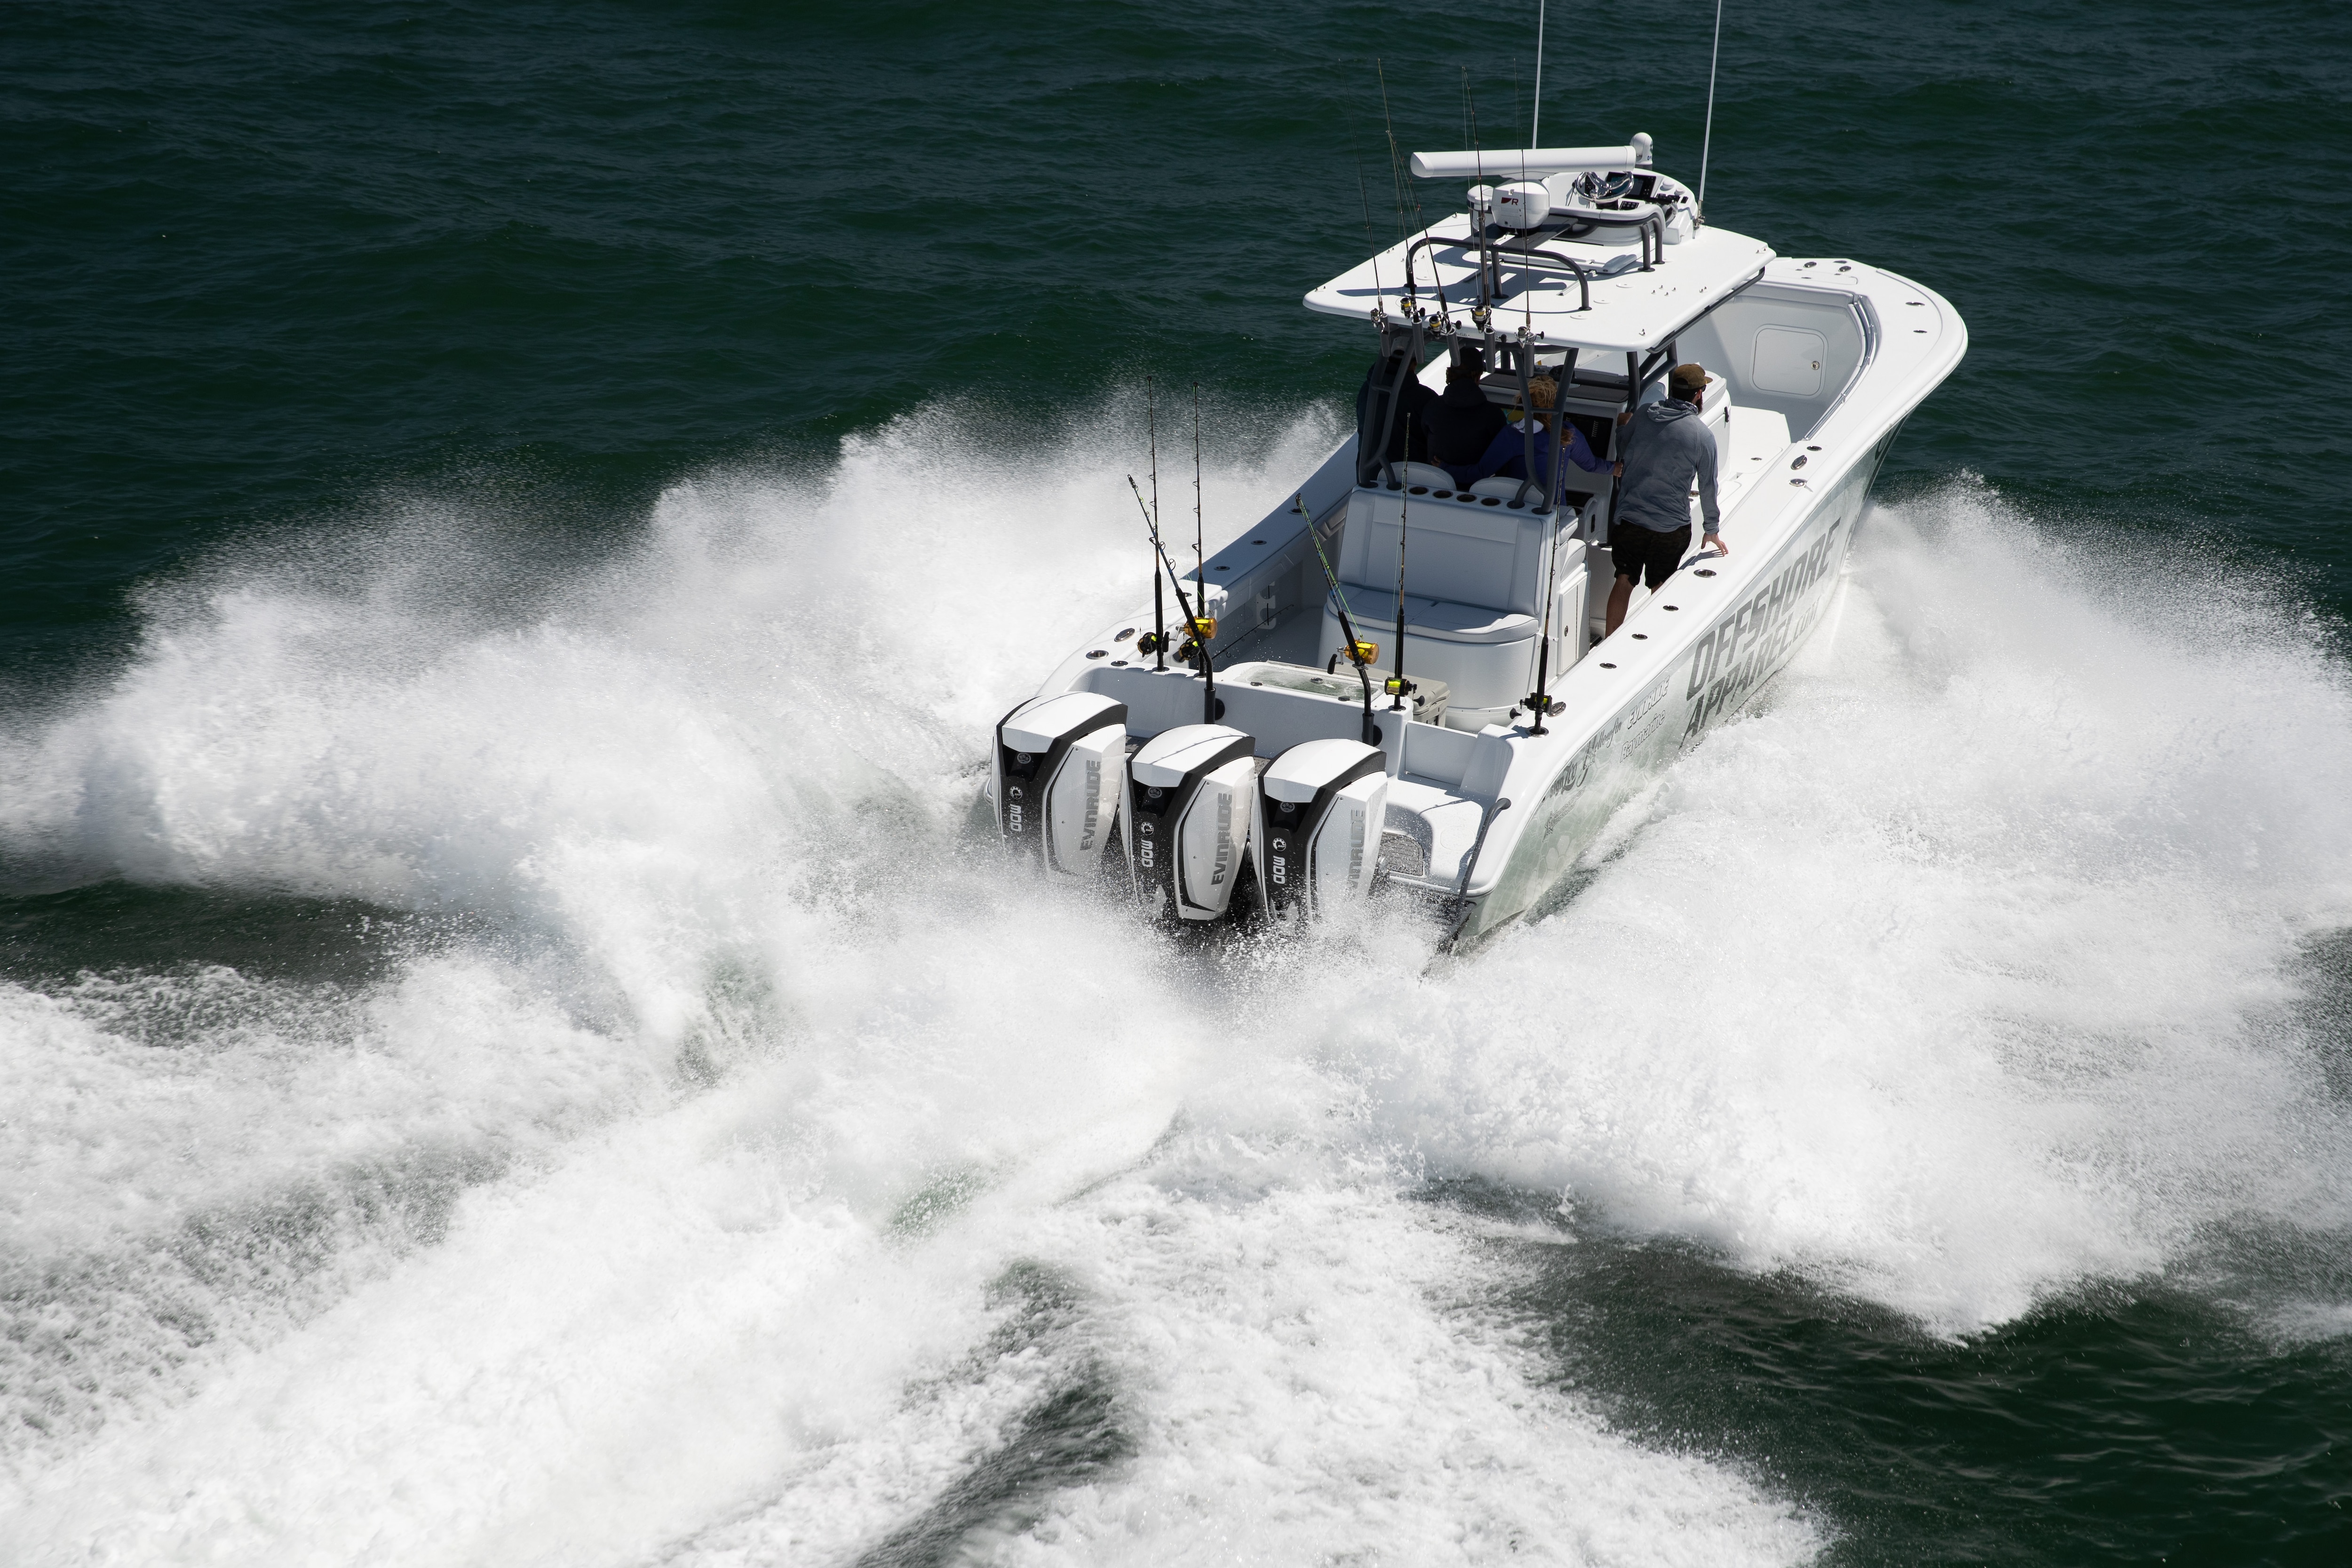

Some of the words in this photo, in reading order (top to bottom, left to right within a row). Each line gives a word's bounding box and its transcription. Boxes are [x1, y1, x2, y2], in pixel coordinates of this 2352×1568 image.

[1686, 516, 1841, 701] OFFSHORE
[1627, 675, 1670, 730] EVINRUDE
[1620, 710, 1666, 763] Raymarine
[1010, 804, 1022, 832] 300
[1080, 759, 1101, 851] EVINRUDE
[1141, 840, 1153, 868] 300
[1211, 792, 1232, 885] EVINRUDE
[1345, 808, 1365, 896] VINRUDE
[1273, 855, 1286, 884] 300
